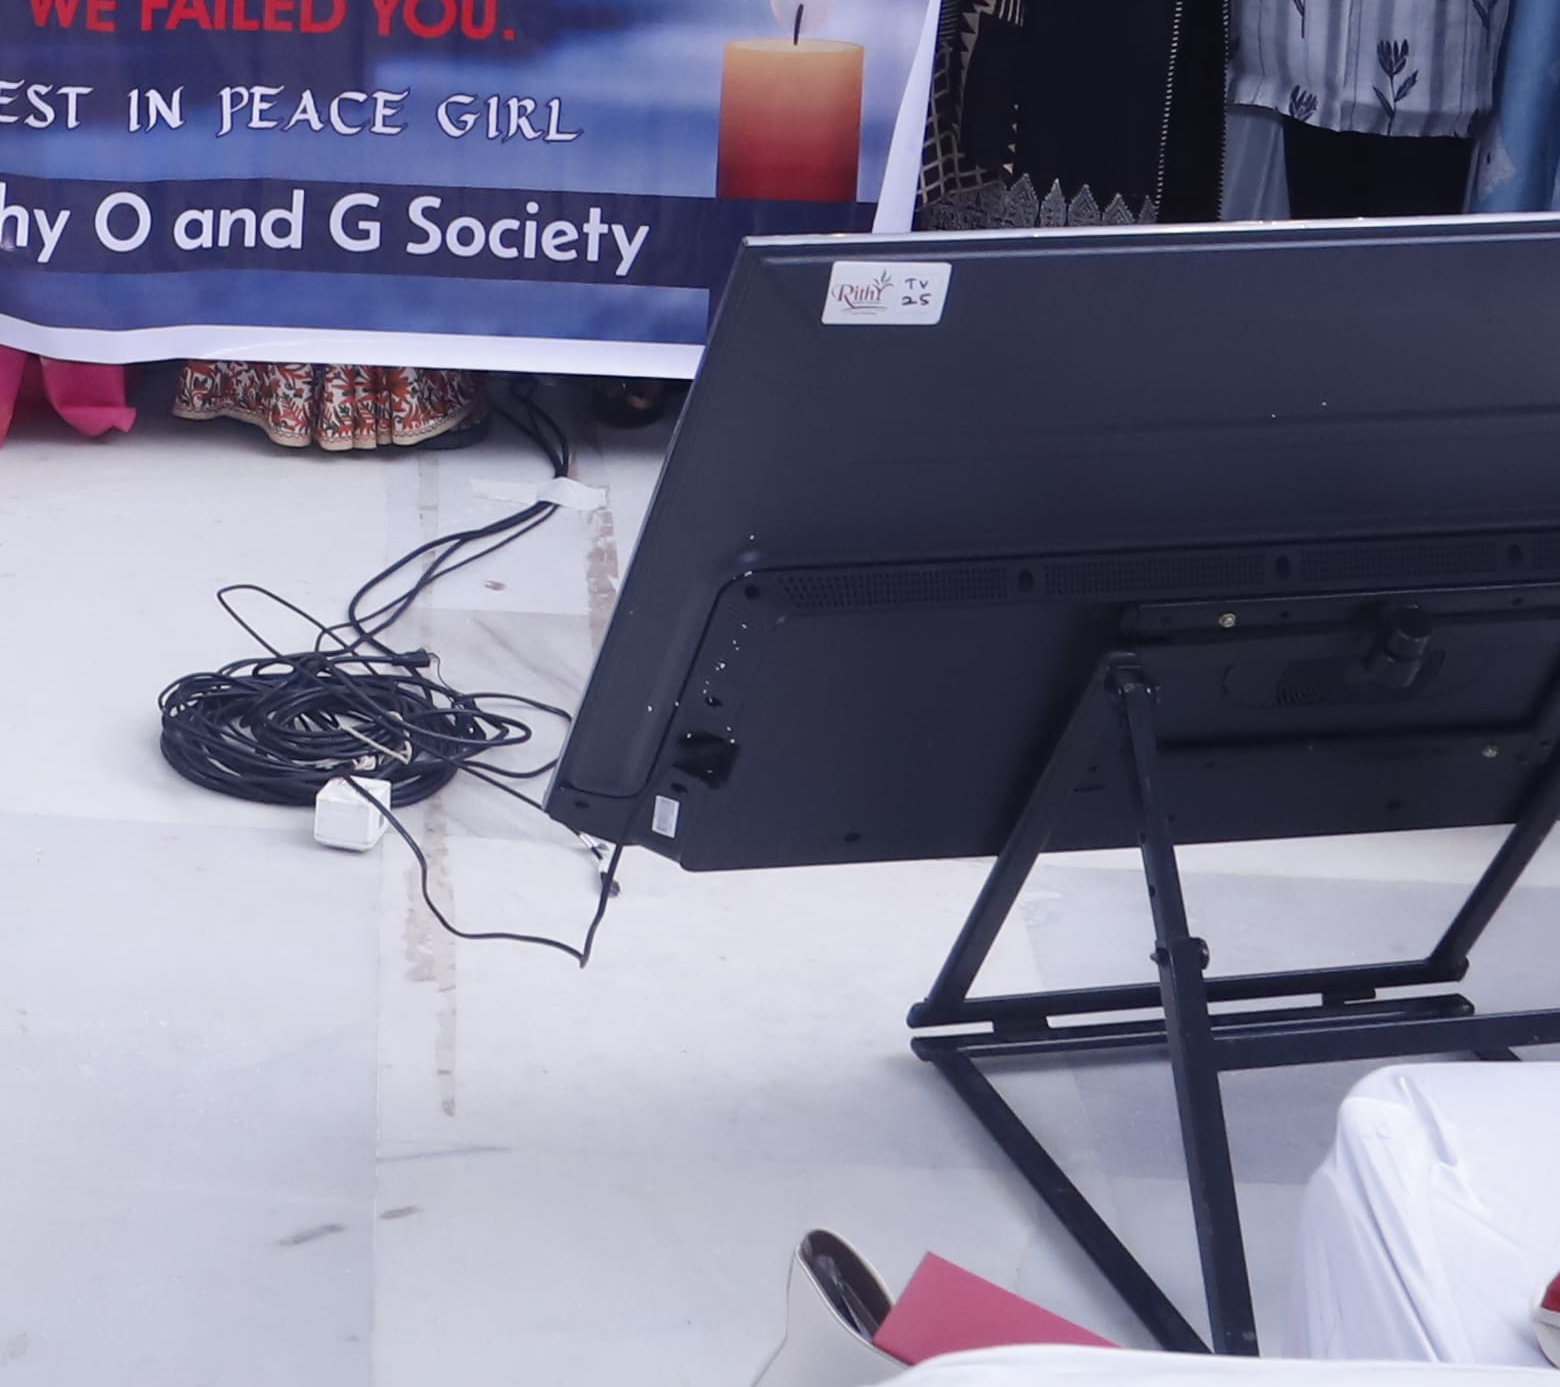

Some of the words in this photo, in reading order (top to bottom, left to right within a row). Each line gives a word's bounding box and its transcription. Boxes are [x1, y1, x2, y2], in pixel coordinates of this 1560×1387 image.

[127, 85, 185, 133] IN
[216, 84, 411, 138] PEACE
[437, 93, 584, 142] GIRL
[94, 190, 152, 253] O
[173, 189, 305, 252] and
[328, 193, 381, 252] G
[407, 197, 650, 276] Society
